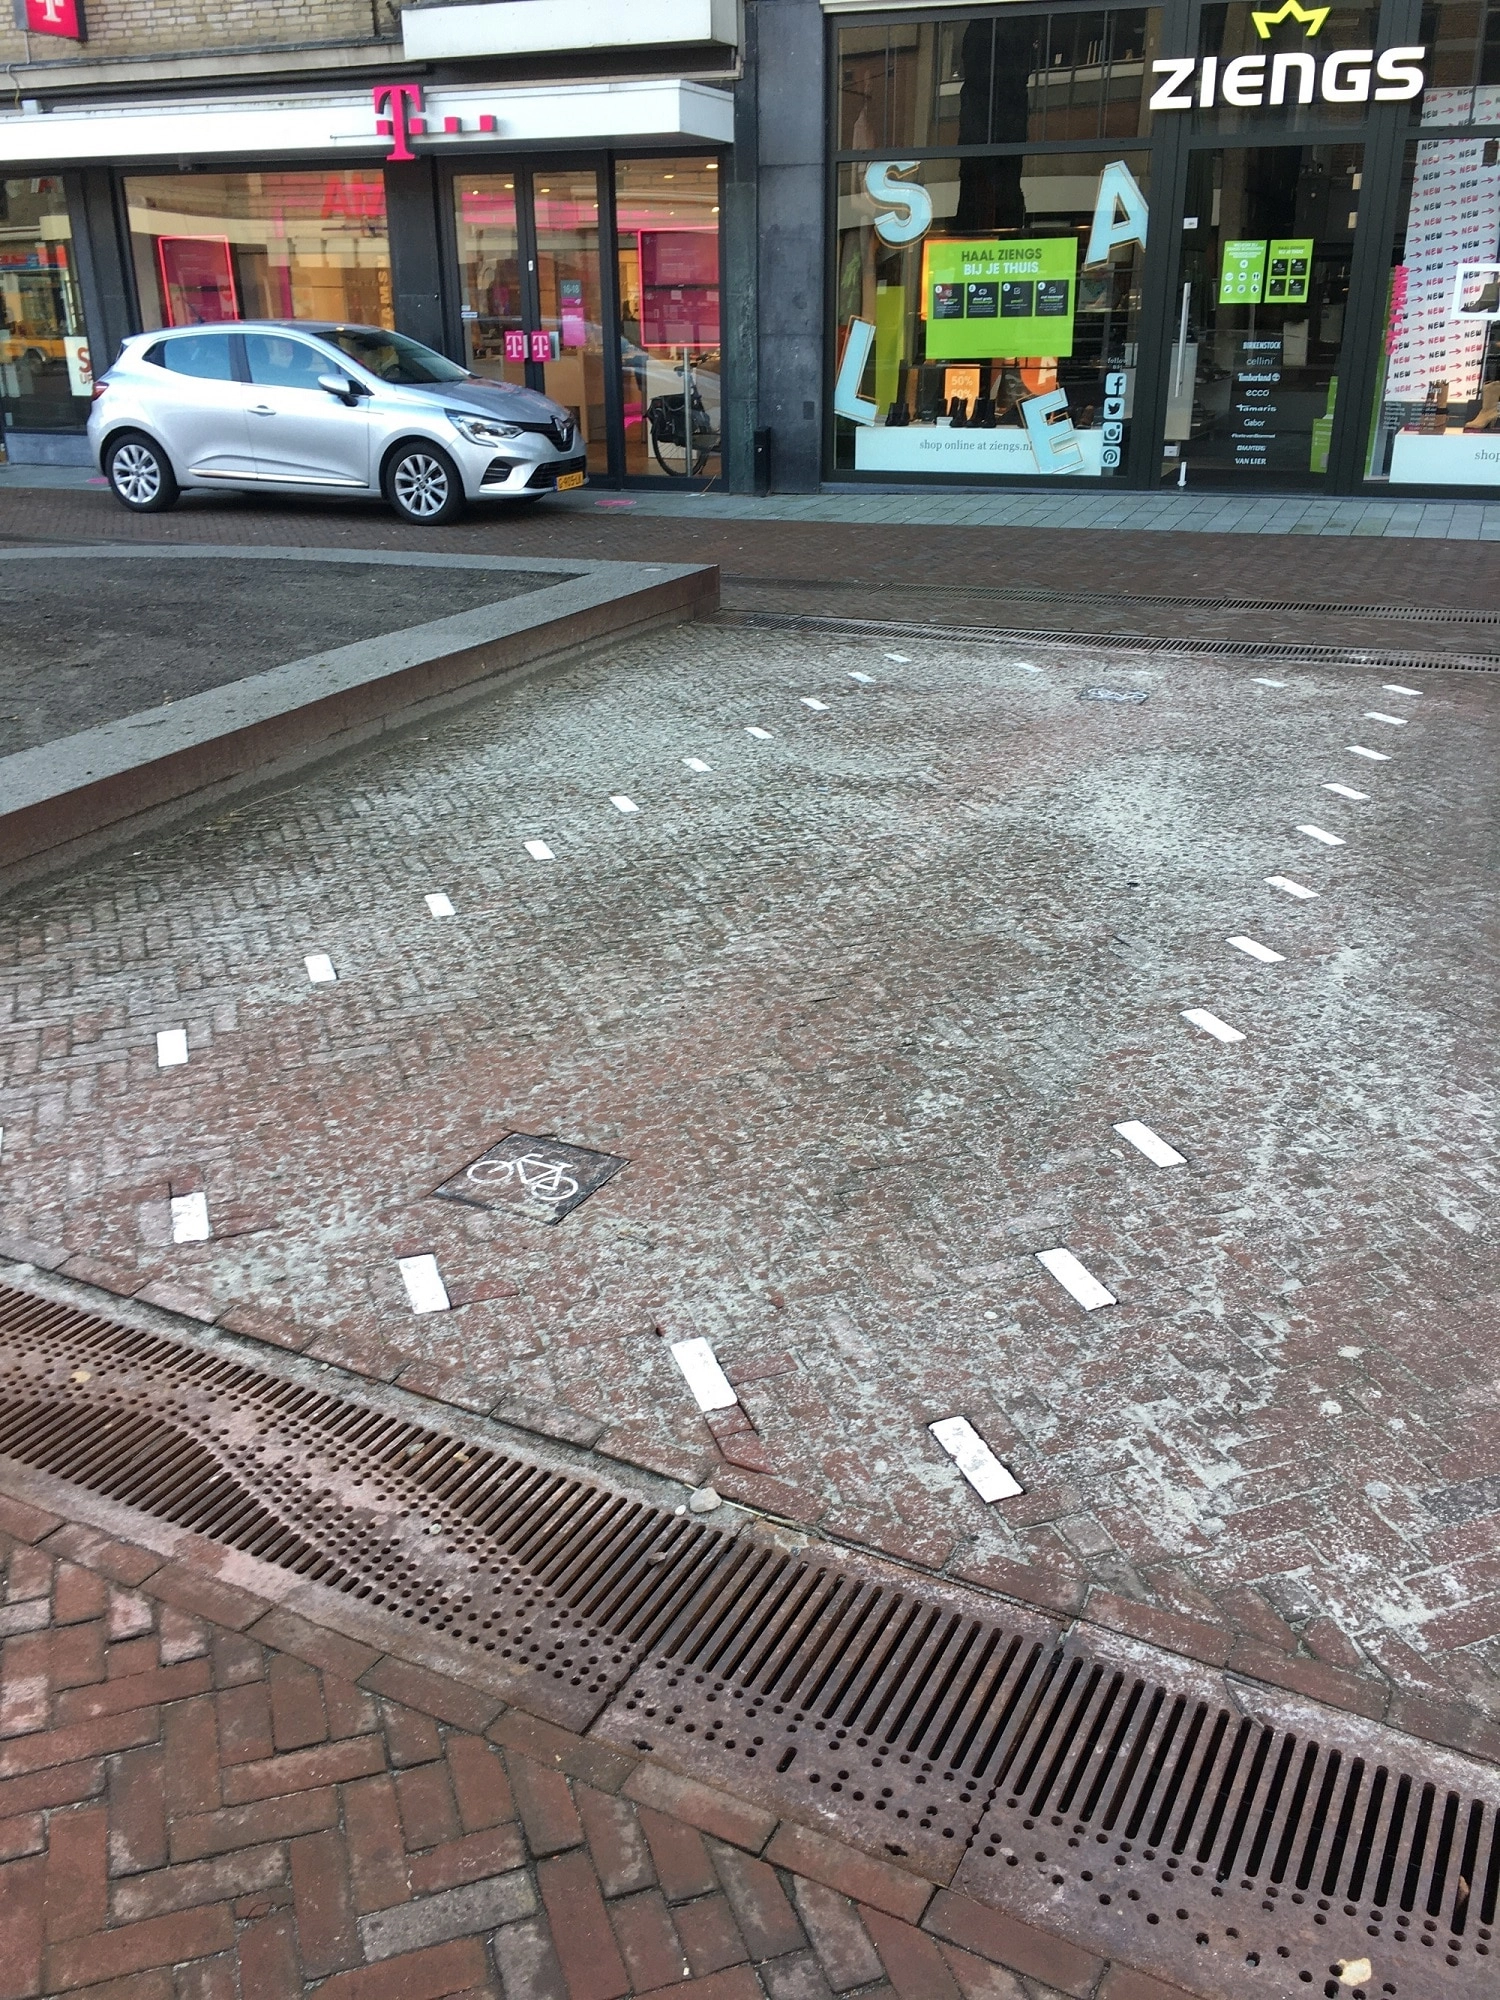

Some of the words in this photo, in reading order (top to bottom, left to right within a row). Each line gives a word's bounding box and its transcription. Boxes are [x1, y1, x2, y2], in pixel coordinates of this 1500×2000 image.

[1149, 46, 1426, 110] ZIENGS
[865, 160, 932, 248] S
[1083, 160, 1149, 271] A
[962, 250, 994, 262] HAAL
[998, 248, 1042, 260] ZIENGS
[964, 264, 982, 275] BIJ
[986, 262, 1000, 274] JE
[1004, 262, 1040, 274] THUIS
[1238, 373, 1272, 382] Timberland
[834, 315, 880, 427] L
[1017, 388, 1085, 474] E
[1246, 389, 1270, 397] ecco
[1236, 404, 1276, 412] Tamaris
[1244, 418, 1266, 427] Gabor
[920, 440, 942, 452] shop
[944, 440, 975, 450] online
[977, 442, 987, 450] at
